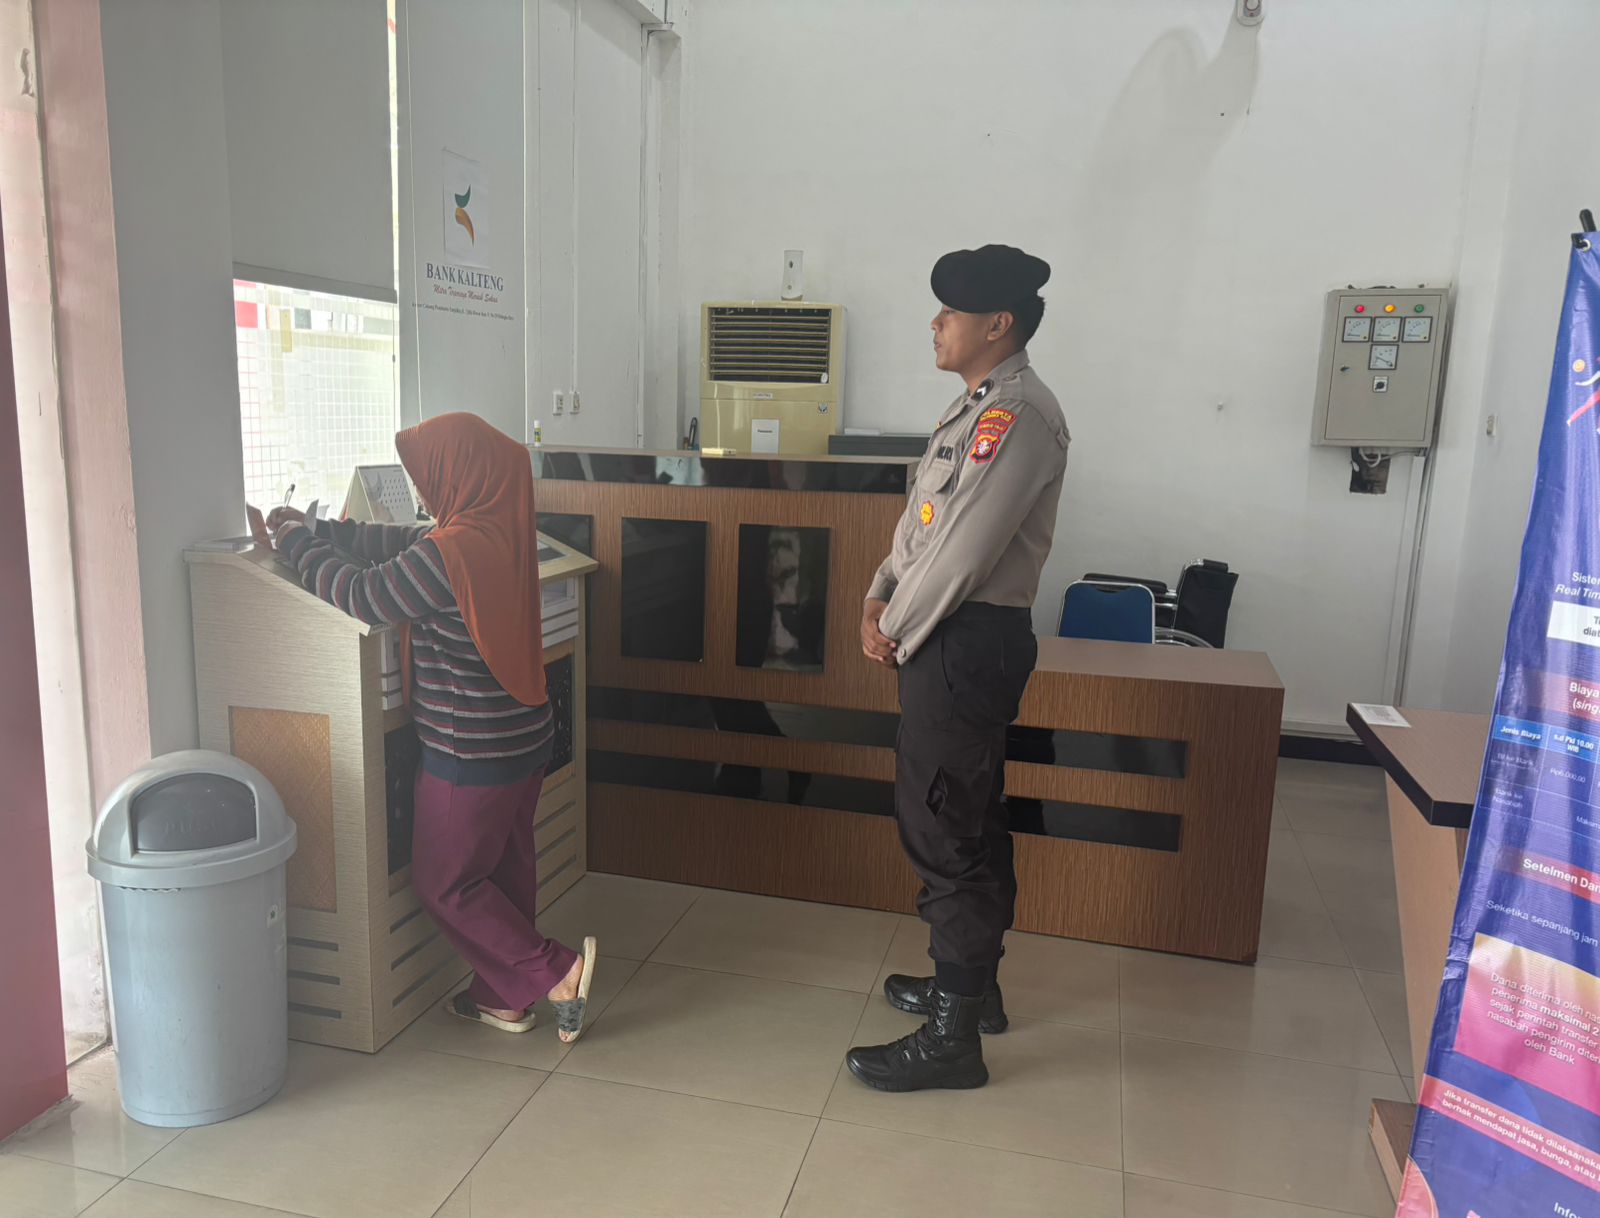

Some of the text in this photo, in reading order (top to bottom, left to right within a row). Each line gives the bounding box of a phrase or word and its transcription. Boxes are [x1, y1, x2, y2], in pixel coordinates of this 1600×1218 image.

[426, 263, 456, 284] BANK
[458, 269, 504, 292] KALTENG
[1555, 584, 1581, 596] Real
[1570, 682, 1600, 698] Biaya
[1523, 858, 1578, 884] Setelmen
[1486, 900, 1598, 947] Seketika sepanjang jam
[1490, 972, 1518, 989] Dana
[1520, 984, 1560, 1005] diterima
[1563, 1001, 1584, 1015] oleh
[1491, 987, 1538, 1010] penerima
[1540, 1006, 1591, 1032] maksimal
[1488, 1010, 1528, 1032] nasabah
[1531, 1028, 1576, 1052] pengirim
[1489, 999, 1598, 1048] sejak perintah transfer
[1524, 1039, 1575, 1065] oleh Bank
[1444, 1090, 1462, 1102] Jika
[1464, 1098, 1497, 1118] transfer
[1498, 1116, 1520, 1130] dana
[1522, 1126, 1544, 1142] tidak
[1442, 1098, 1596, 1179] berhak mendapat jasa, bunga, atau
